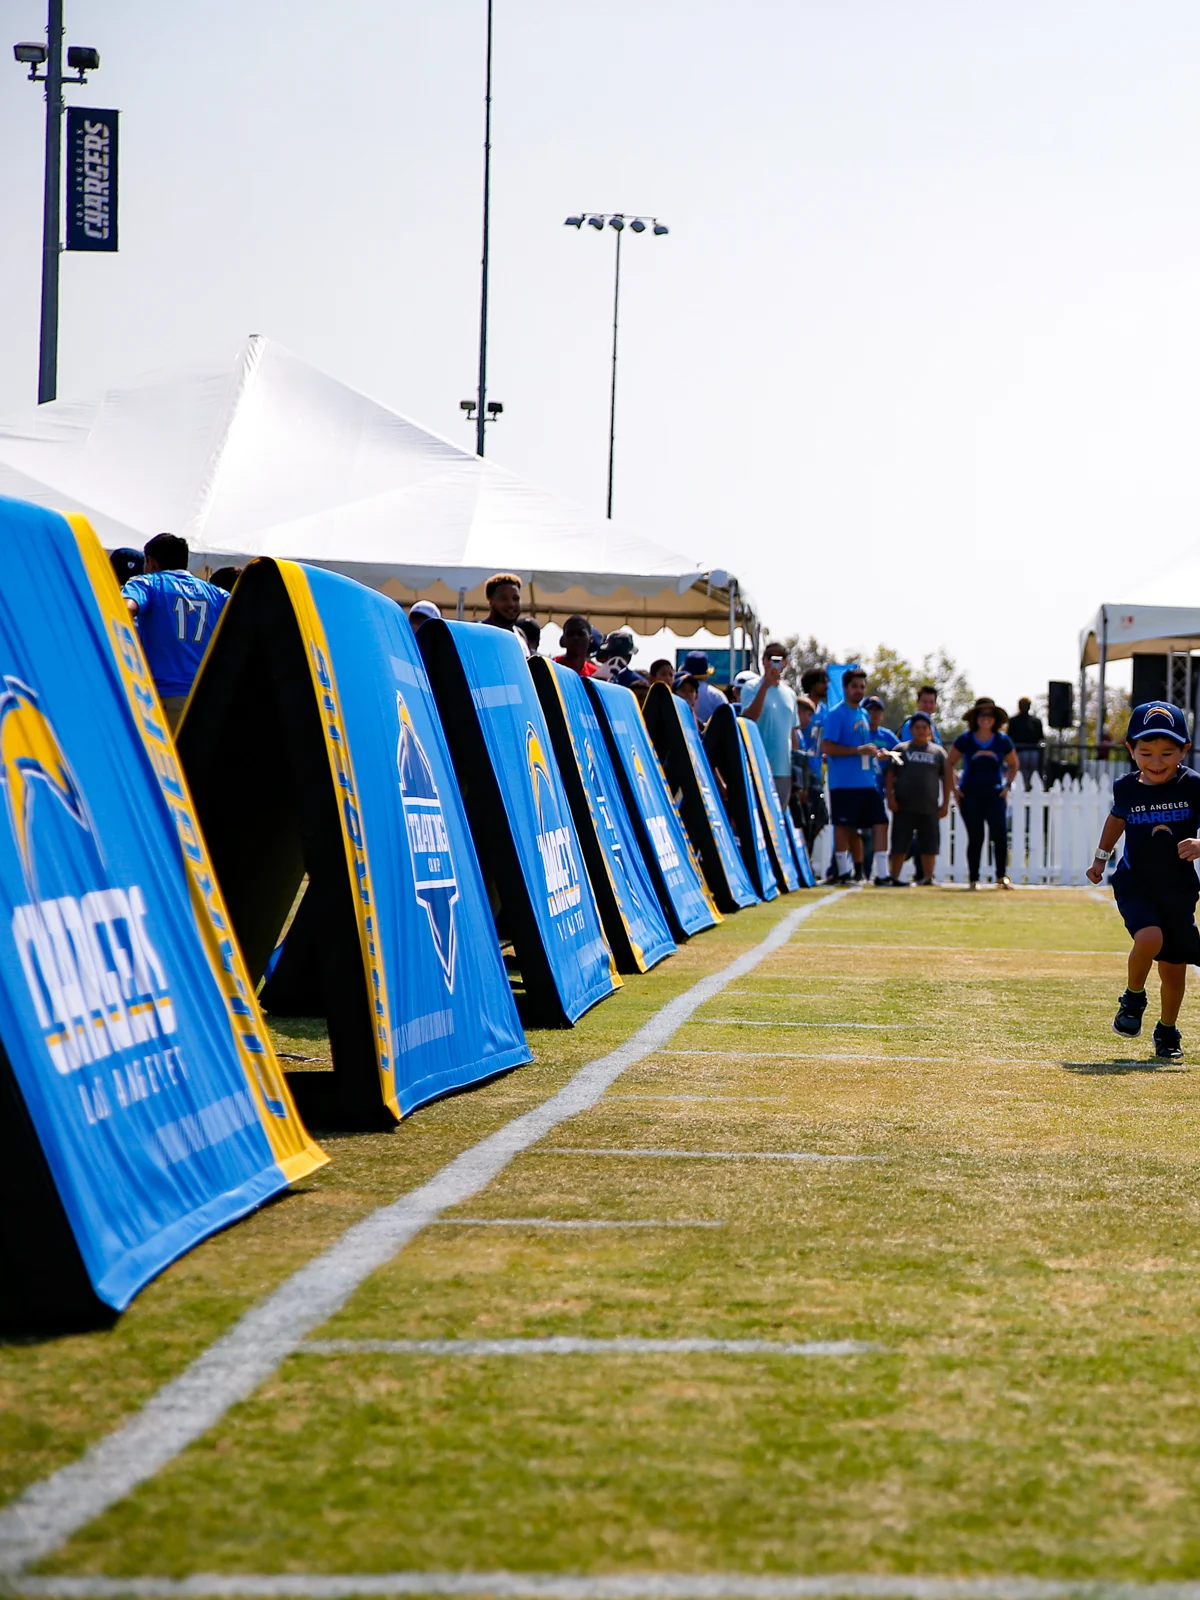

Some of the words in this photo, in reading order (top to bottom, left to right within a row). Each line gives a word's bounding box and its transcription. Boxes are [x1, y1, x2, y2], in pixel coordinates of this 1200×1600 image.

[84, 119, 110, 239] CHARGERS
[173, 596, 208, 642] 17
[905, 751, 937, 765] VANS
[1131, 804, 1147, 813] LOS
[1150, 800, 1189, 812] ANGELES
